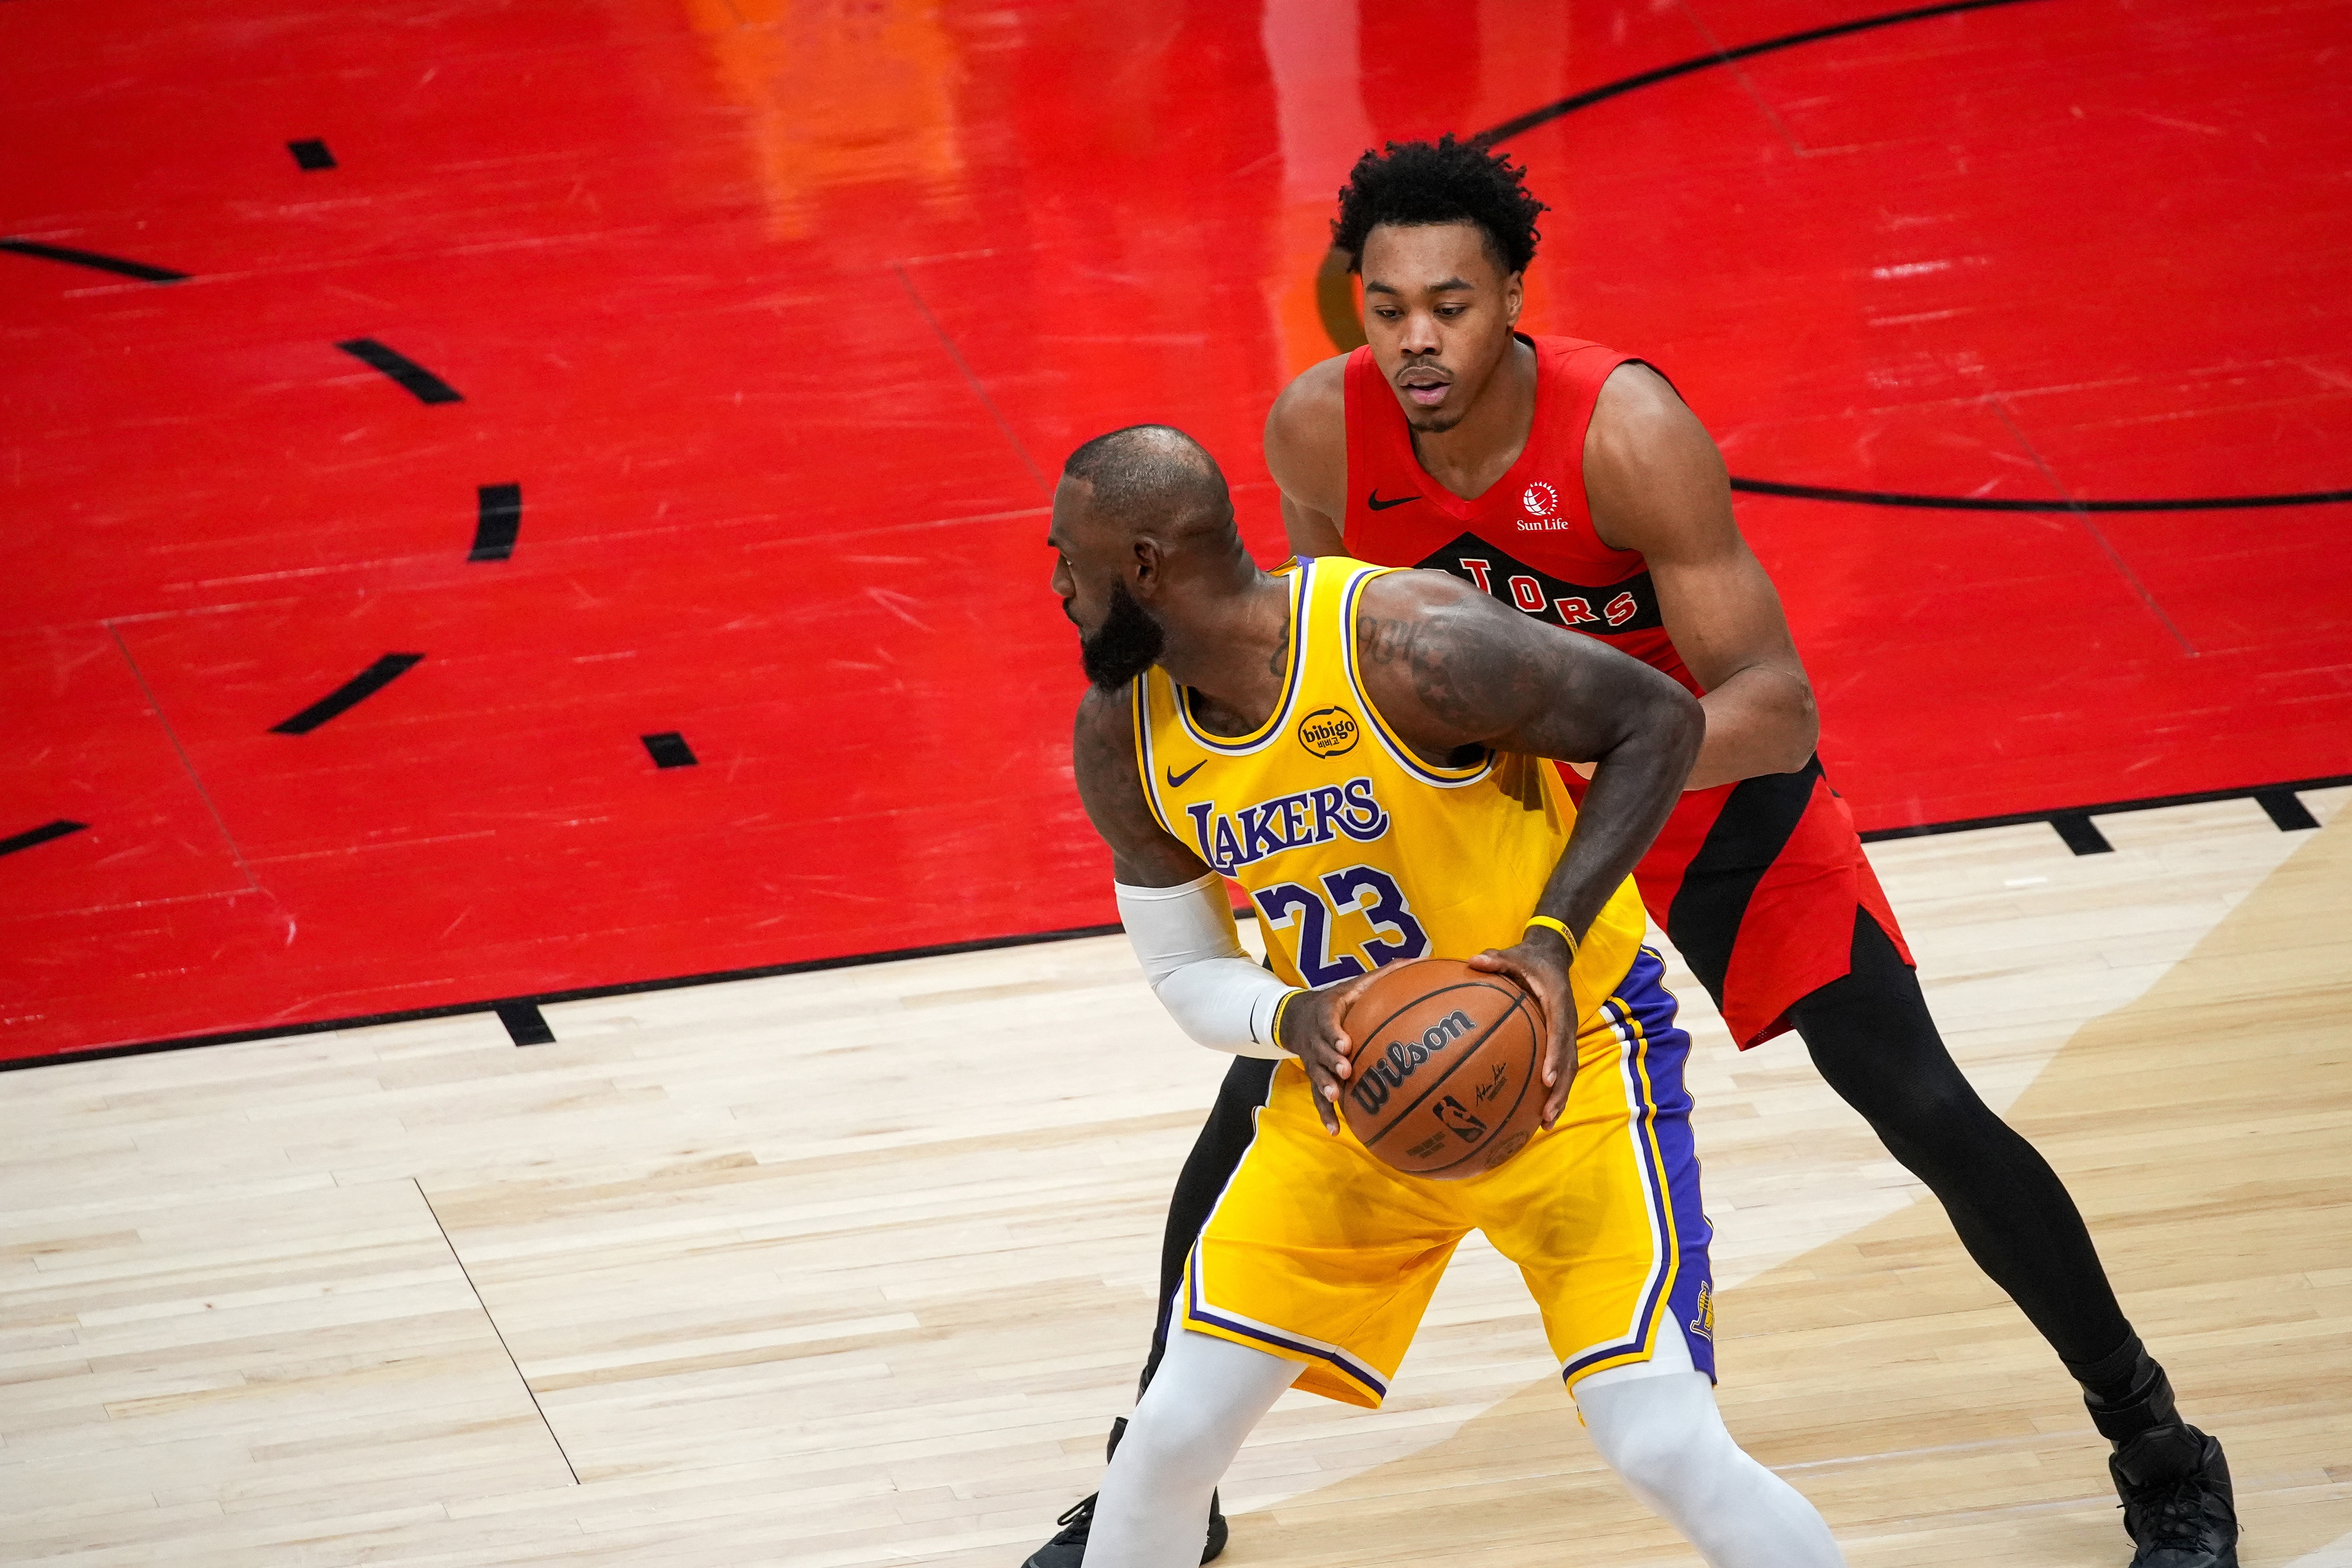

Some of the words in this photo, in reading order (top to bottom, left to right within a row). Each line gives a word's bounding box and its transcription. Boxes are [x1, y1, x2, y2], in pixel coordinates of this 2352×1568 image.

[1517, 520, 1543, 531] Sun
[1543, 518, 1569, 530] Life
[1423, 558, 1637, 626] TORS
[1302, 720, 1355, 743] bibigo
[1317, 737, 1340, 748] 비비고
[1185, 777, 1390, 878] LAKERS
[1250, 863, 1433, 989] 23
[1351, 1009, 1477, 1116] Wilson
